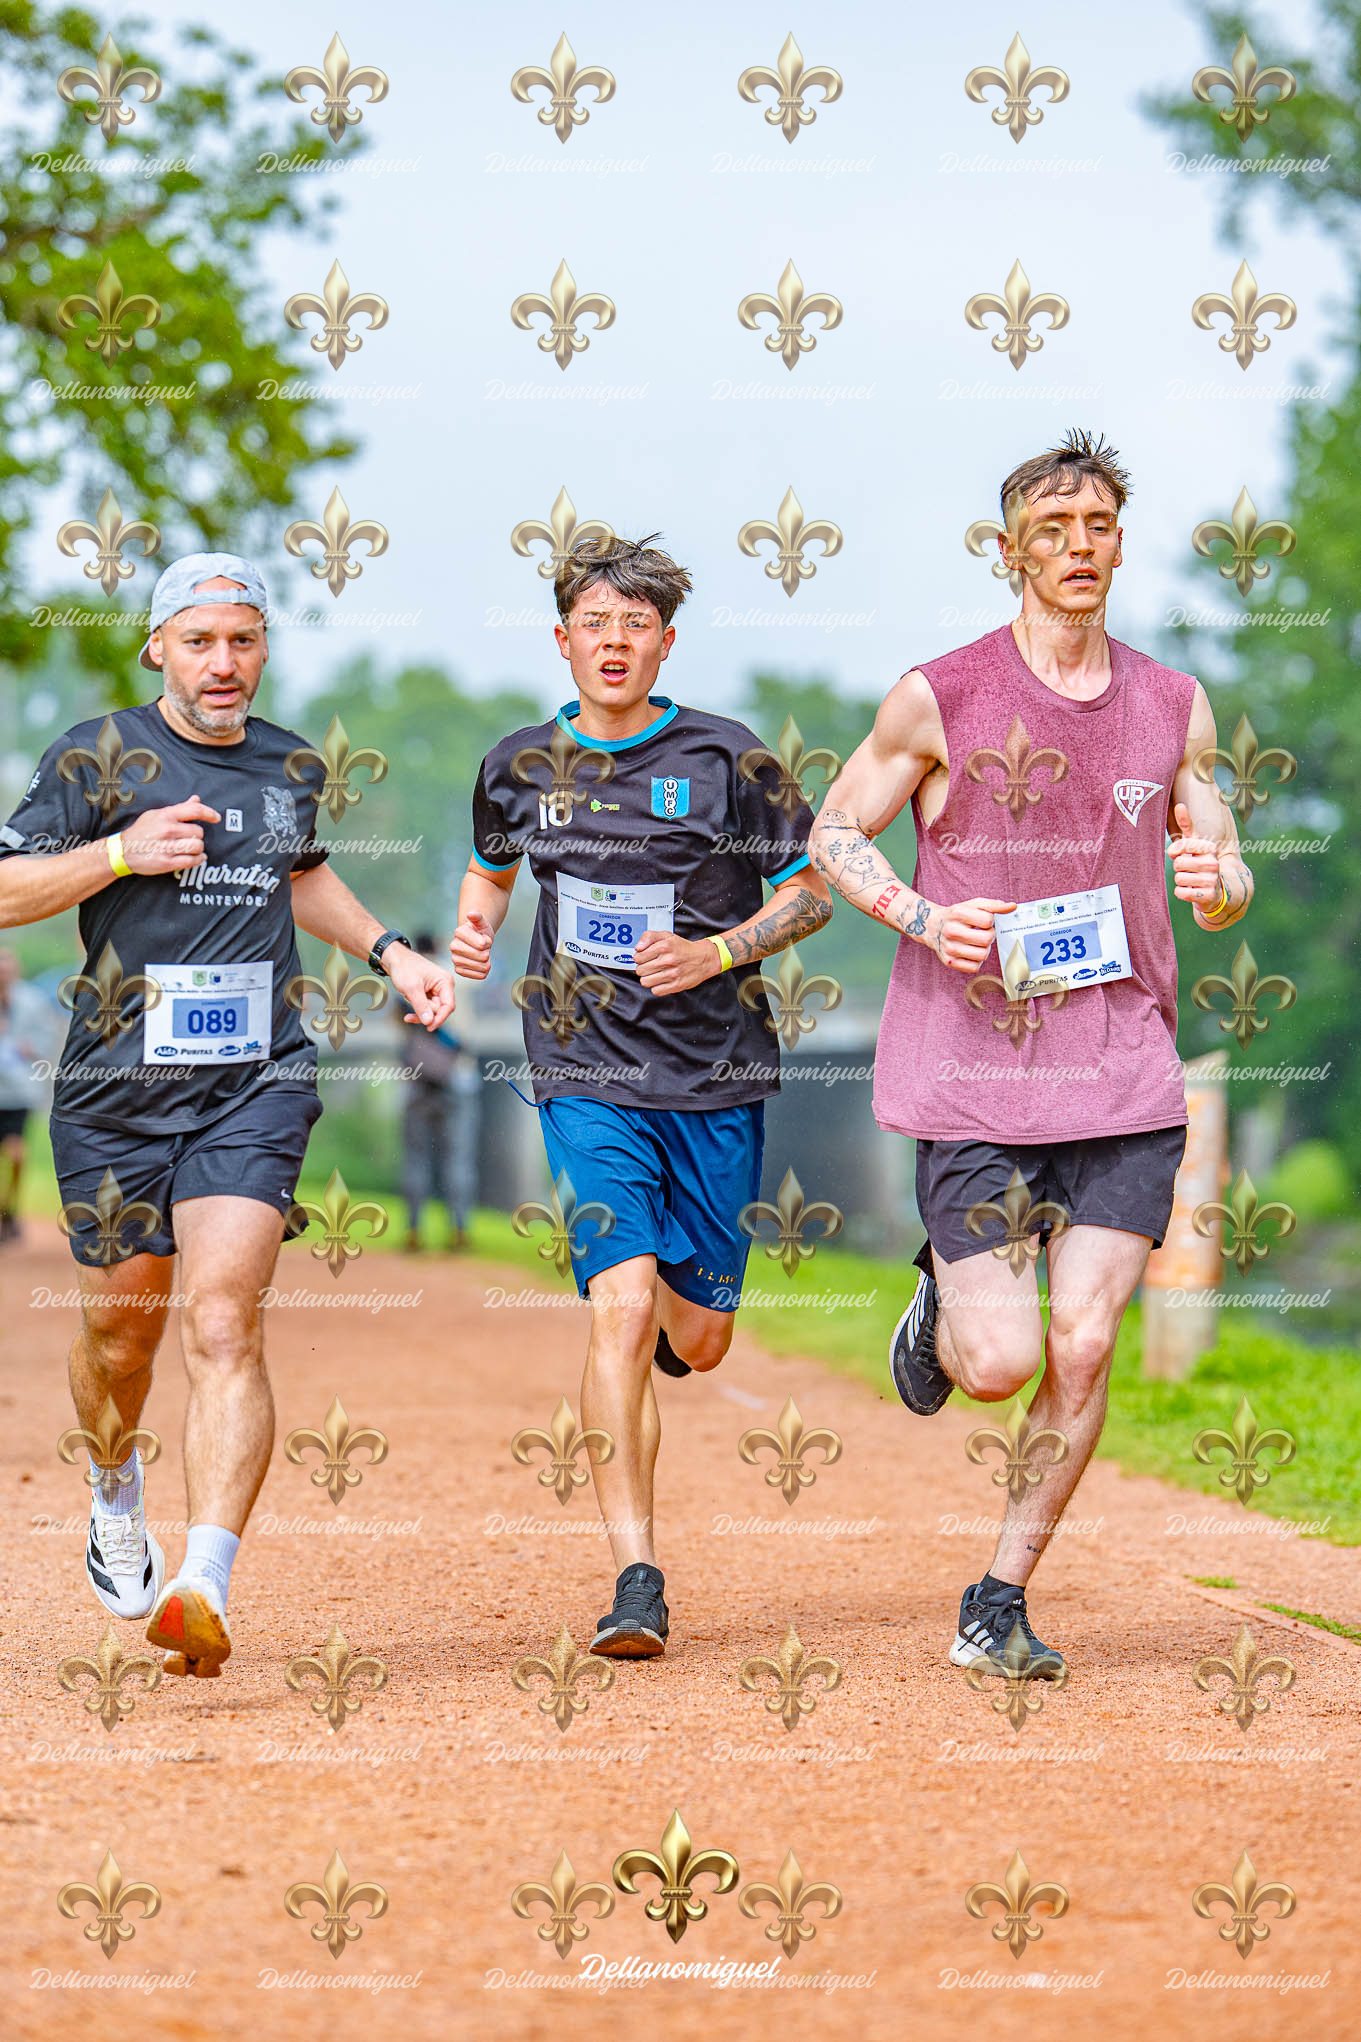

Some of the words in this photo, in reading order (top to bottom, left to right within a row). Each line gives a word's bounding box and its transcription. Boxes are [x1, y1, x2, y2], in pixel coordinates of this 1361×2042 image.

[588, 919, 633, 945] 228
[1040, 935, 1087, 966] 233
[188, 1009, 237, 1034] 089
